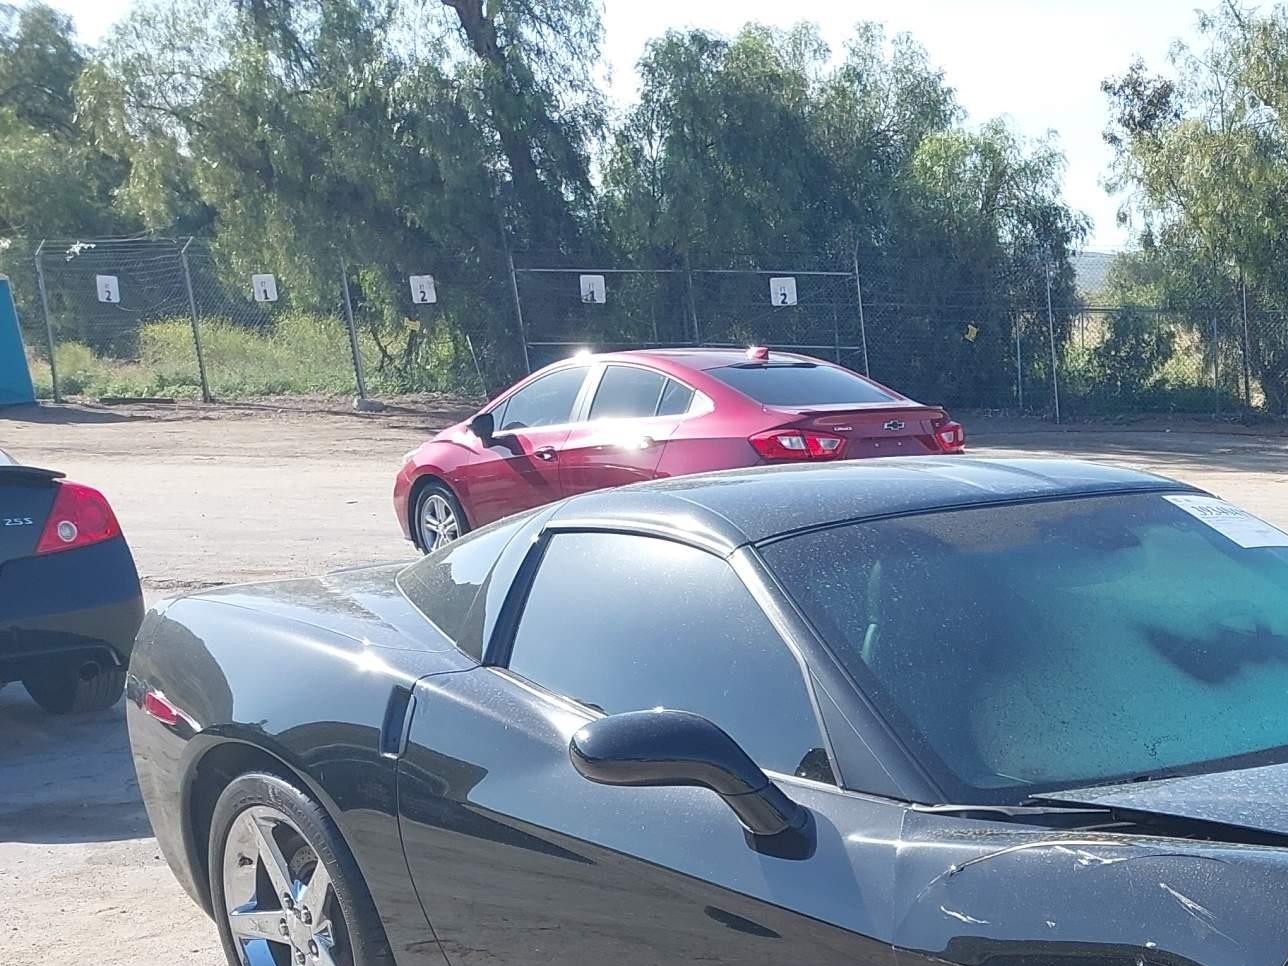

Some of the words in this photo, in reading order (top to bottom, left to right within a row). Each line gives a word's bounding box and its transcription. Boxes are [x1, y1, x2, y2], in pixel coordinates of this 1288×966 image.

[105, 290, 112, 301] 2
[263, 289, 270, 300] 1
[420, 291, 428, 302] 2
[780, 293, 788, 304] 2
